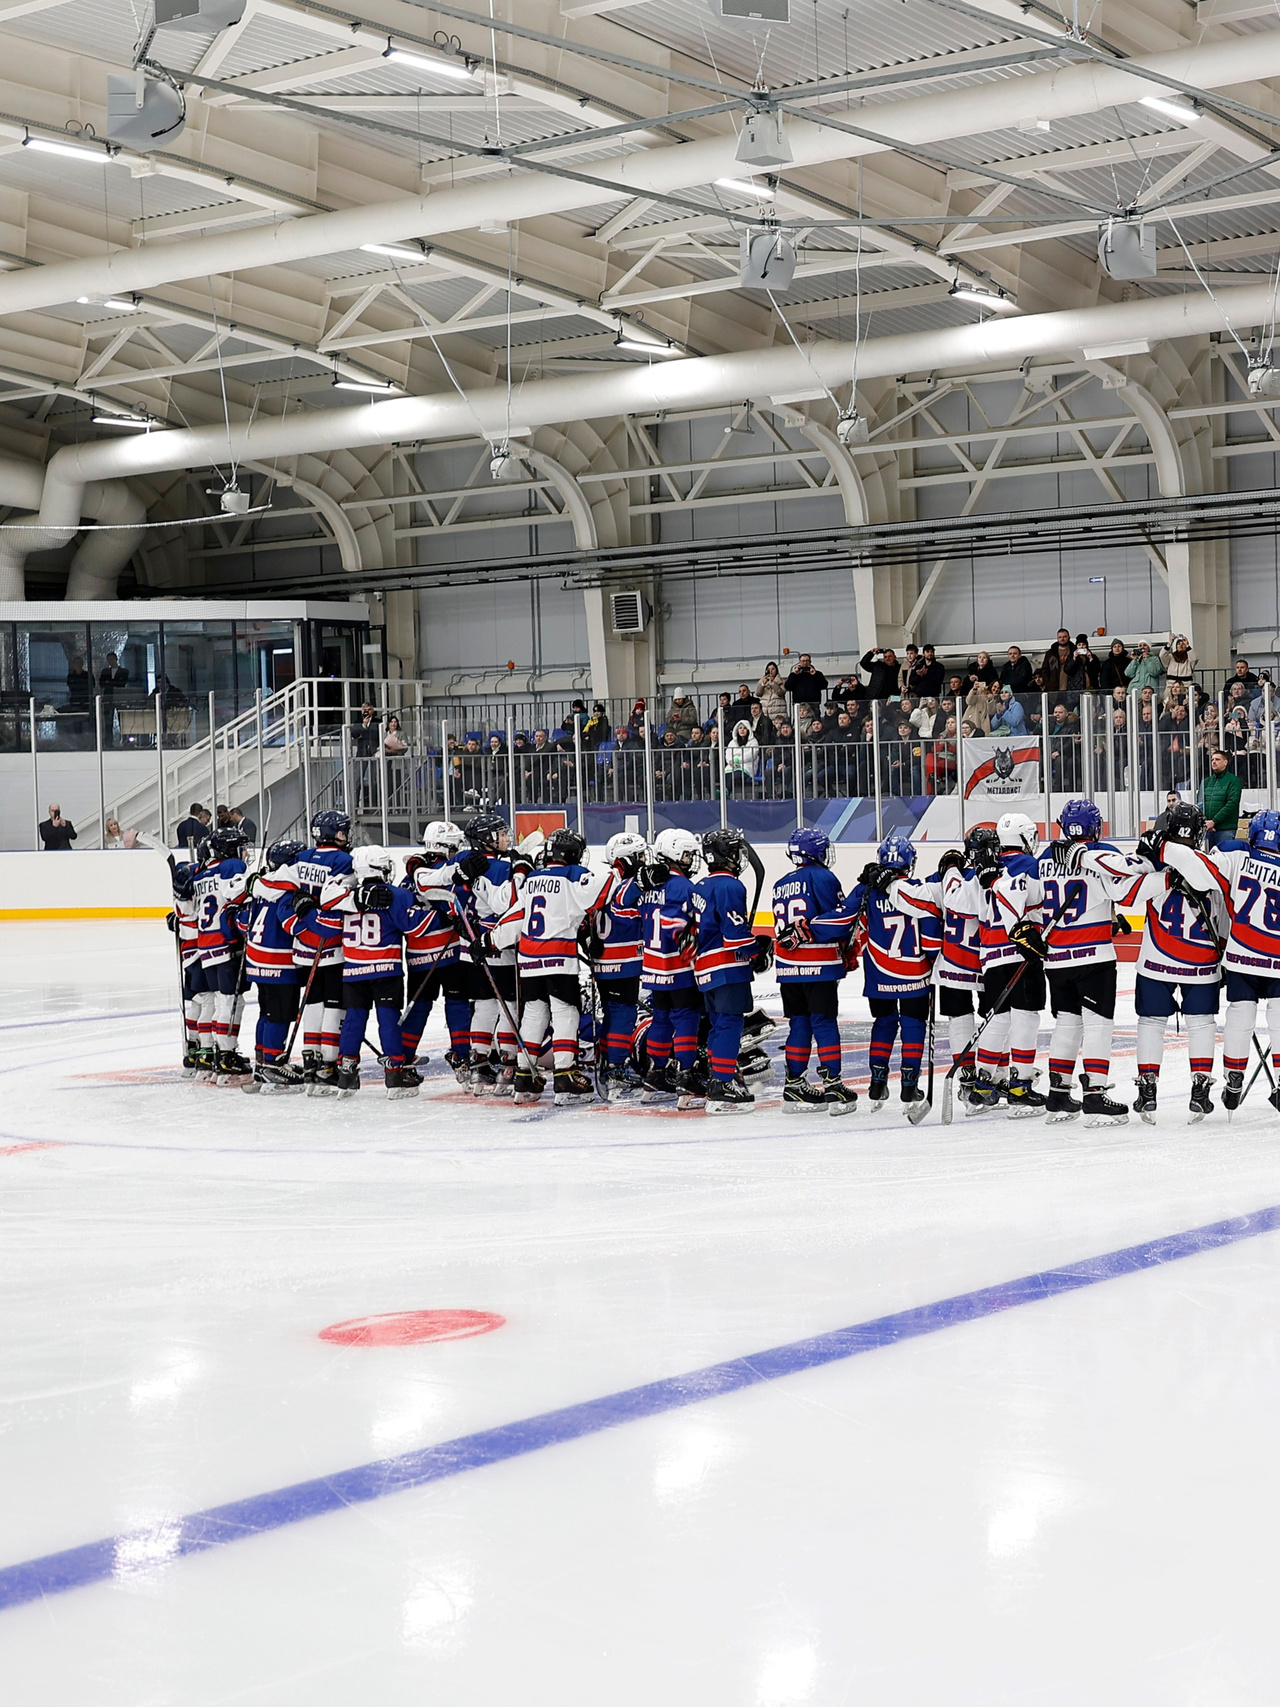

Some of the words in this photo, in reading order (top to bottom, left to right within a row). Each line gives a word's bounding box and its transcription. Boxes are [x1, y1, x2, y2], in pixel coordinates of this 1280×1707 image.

[987, 786, 1021, 795] МЕТАЛЛИСТ
[312, 826, 321, 837] 55
[1069, 825, 1083, 836] 99
[1178, 827, 1191, 838] 42
[1264, 829, 1275, 841] 78
[887, 852, 898, 863] 71
[1042, 879, 1088, 928] 99
[528, 895, 547, 938] 6
[1160, 889, 1212, 940] 42
[342, 913, 381, 948] 58
[882, 915, 921, 960] 71
[800, 966, 822, 976] ОКРУГ
